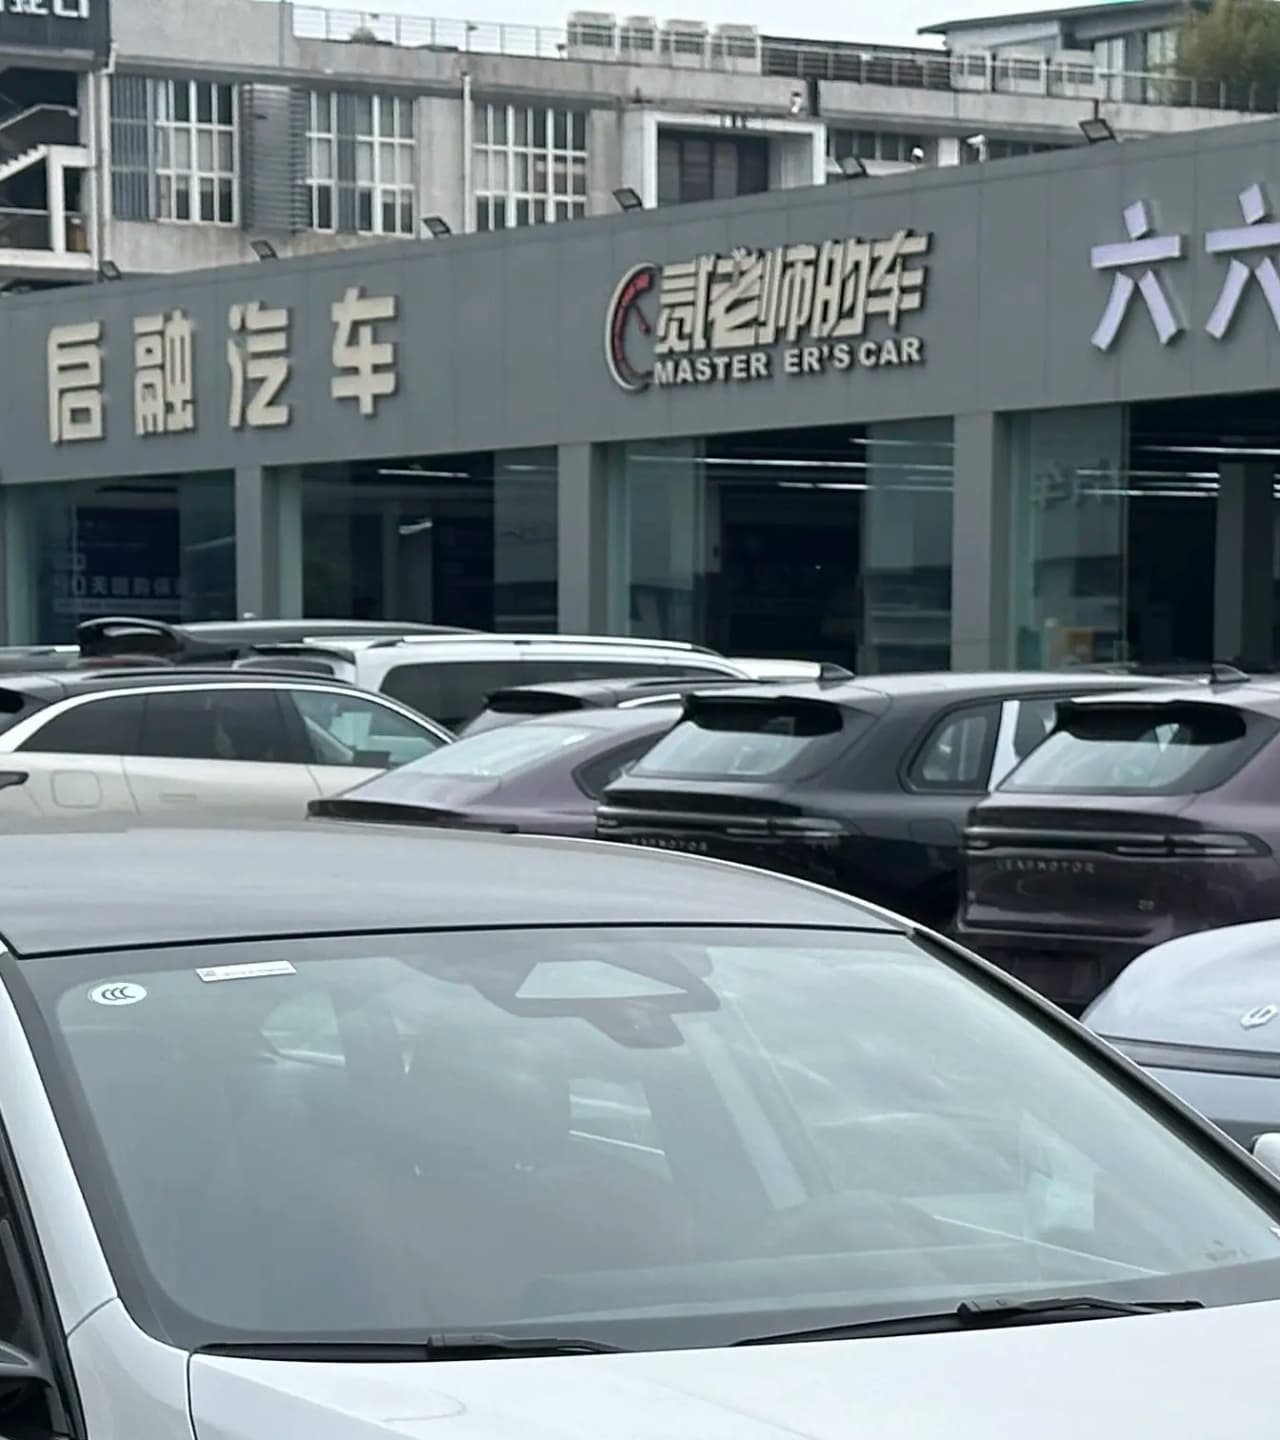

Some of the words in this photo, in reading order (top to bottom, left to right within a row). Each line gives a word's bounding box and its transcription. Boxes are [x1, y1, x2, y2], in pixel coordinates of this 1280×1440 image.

[655, 229, 929, 354] 贰老师的车
[48, 286, 396, 443] 启融汽车
[653, 352, 768, 384] MASTER
[784, 343, 851, 373] ER'S
[858, 336, 921, 366] CAR
